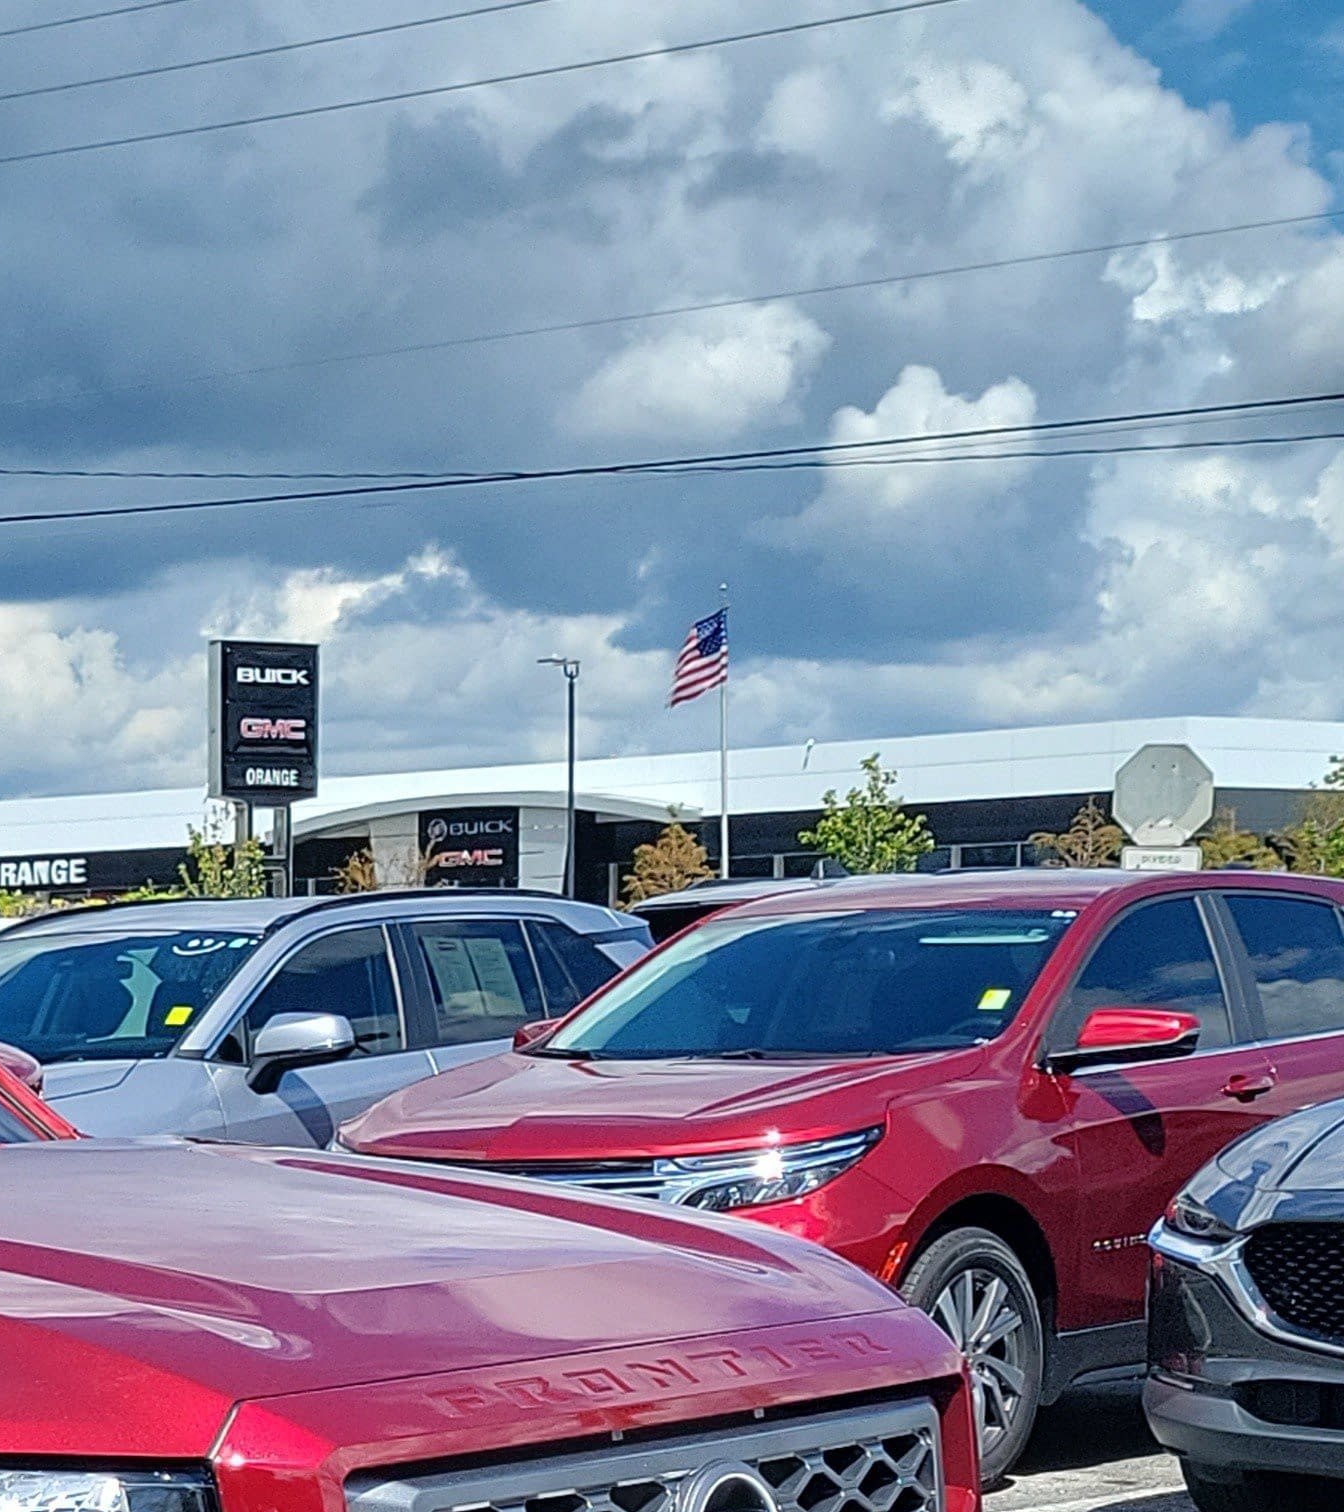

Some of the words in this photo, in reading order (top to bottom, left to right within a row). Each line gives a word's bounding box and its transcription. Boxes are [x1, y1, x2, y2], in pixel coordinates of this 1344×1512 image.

[236, 667, 310, 685] BUICK
[240, 717, 306, 740] GMC
[245, 767, 300, 787] ORANGE
[449, 820, 512, 836] BUICK
[438, 848, 503, 867] GMC
[424, 1331, 892, 1418] FRONTIER
